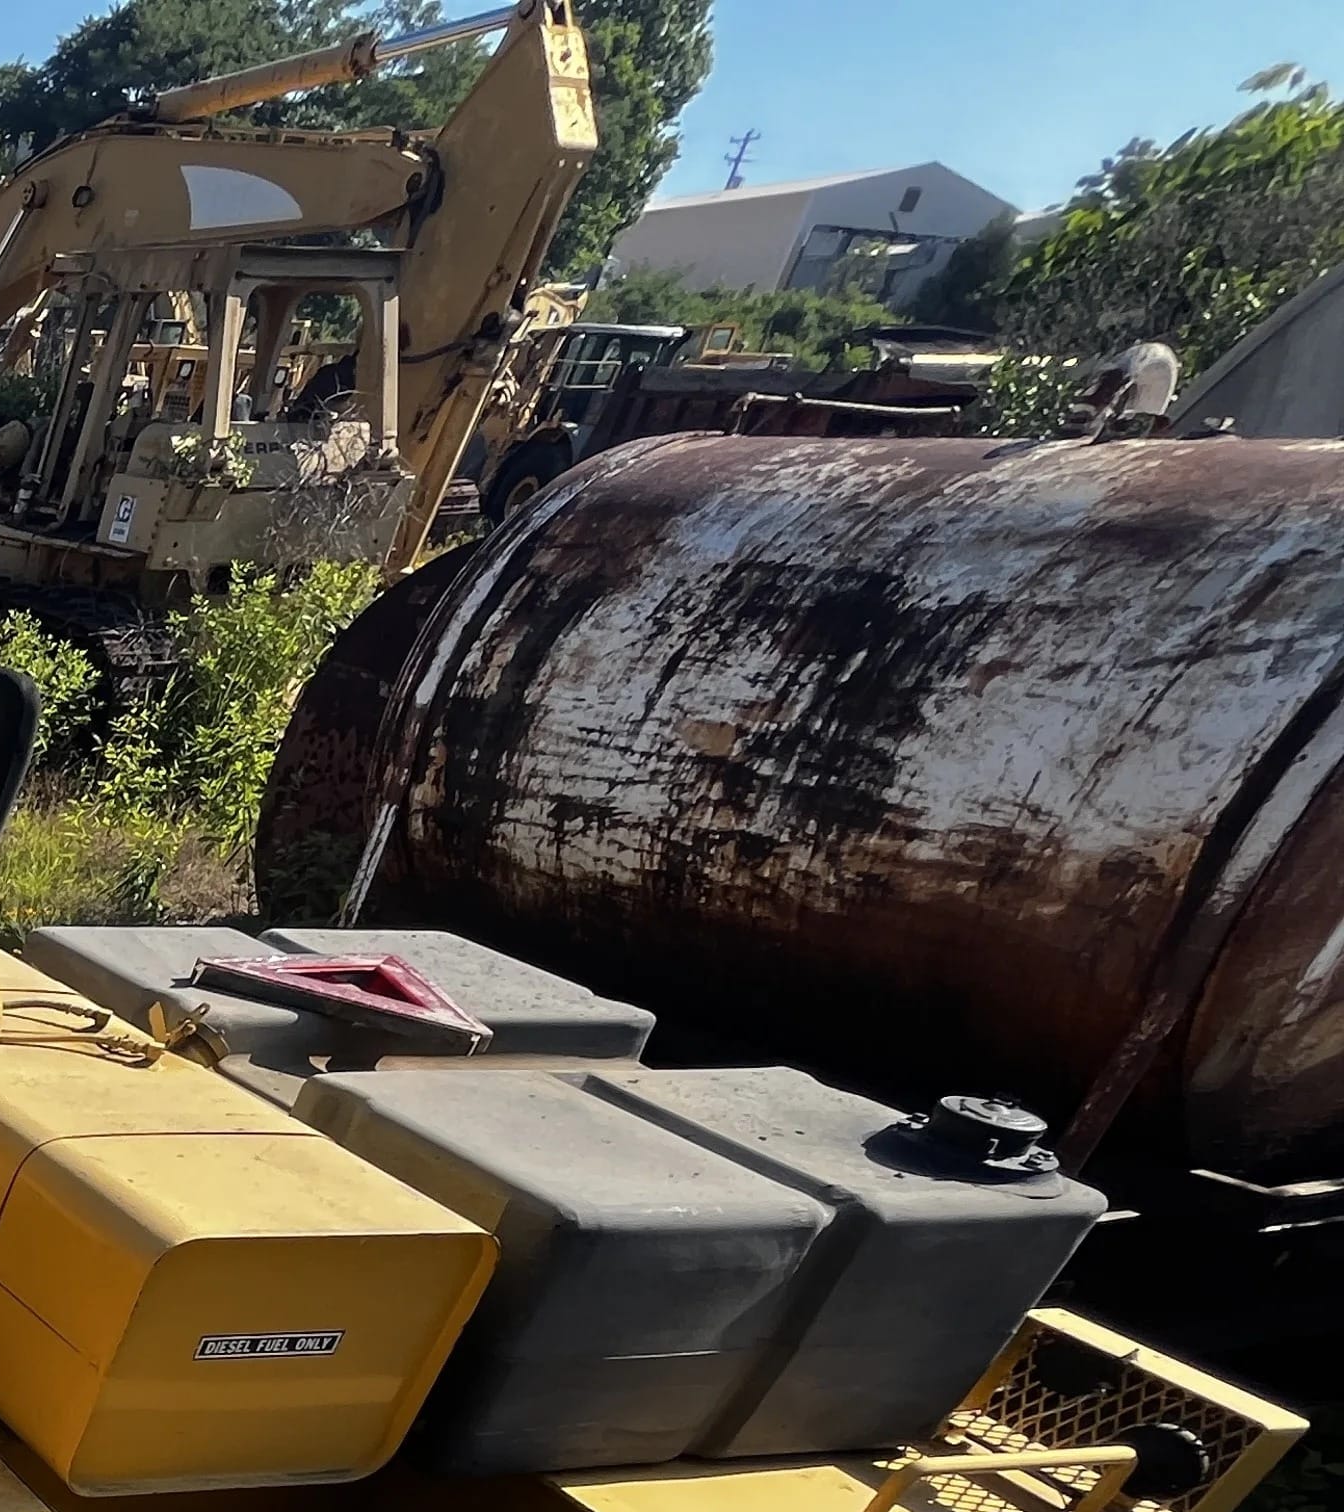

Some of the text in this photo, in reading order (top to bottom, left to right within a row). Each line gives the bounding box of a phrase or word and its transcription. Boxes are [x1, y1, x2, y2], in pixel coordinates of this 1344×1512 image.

[204, 1337, 334, 1355] DIESEL FUEL ONLY
